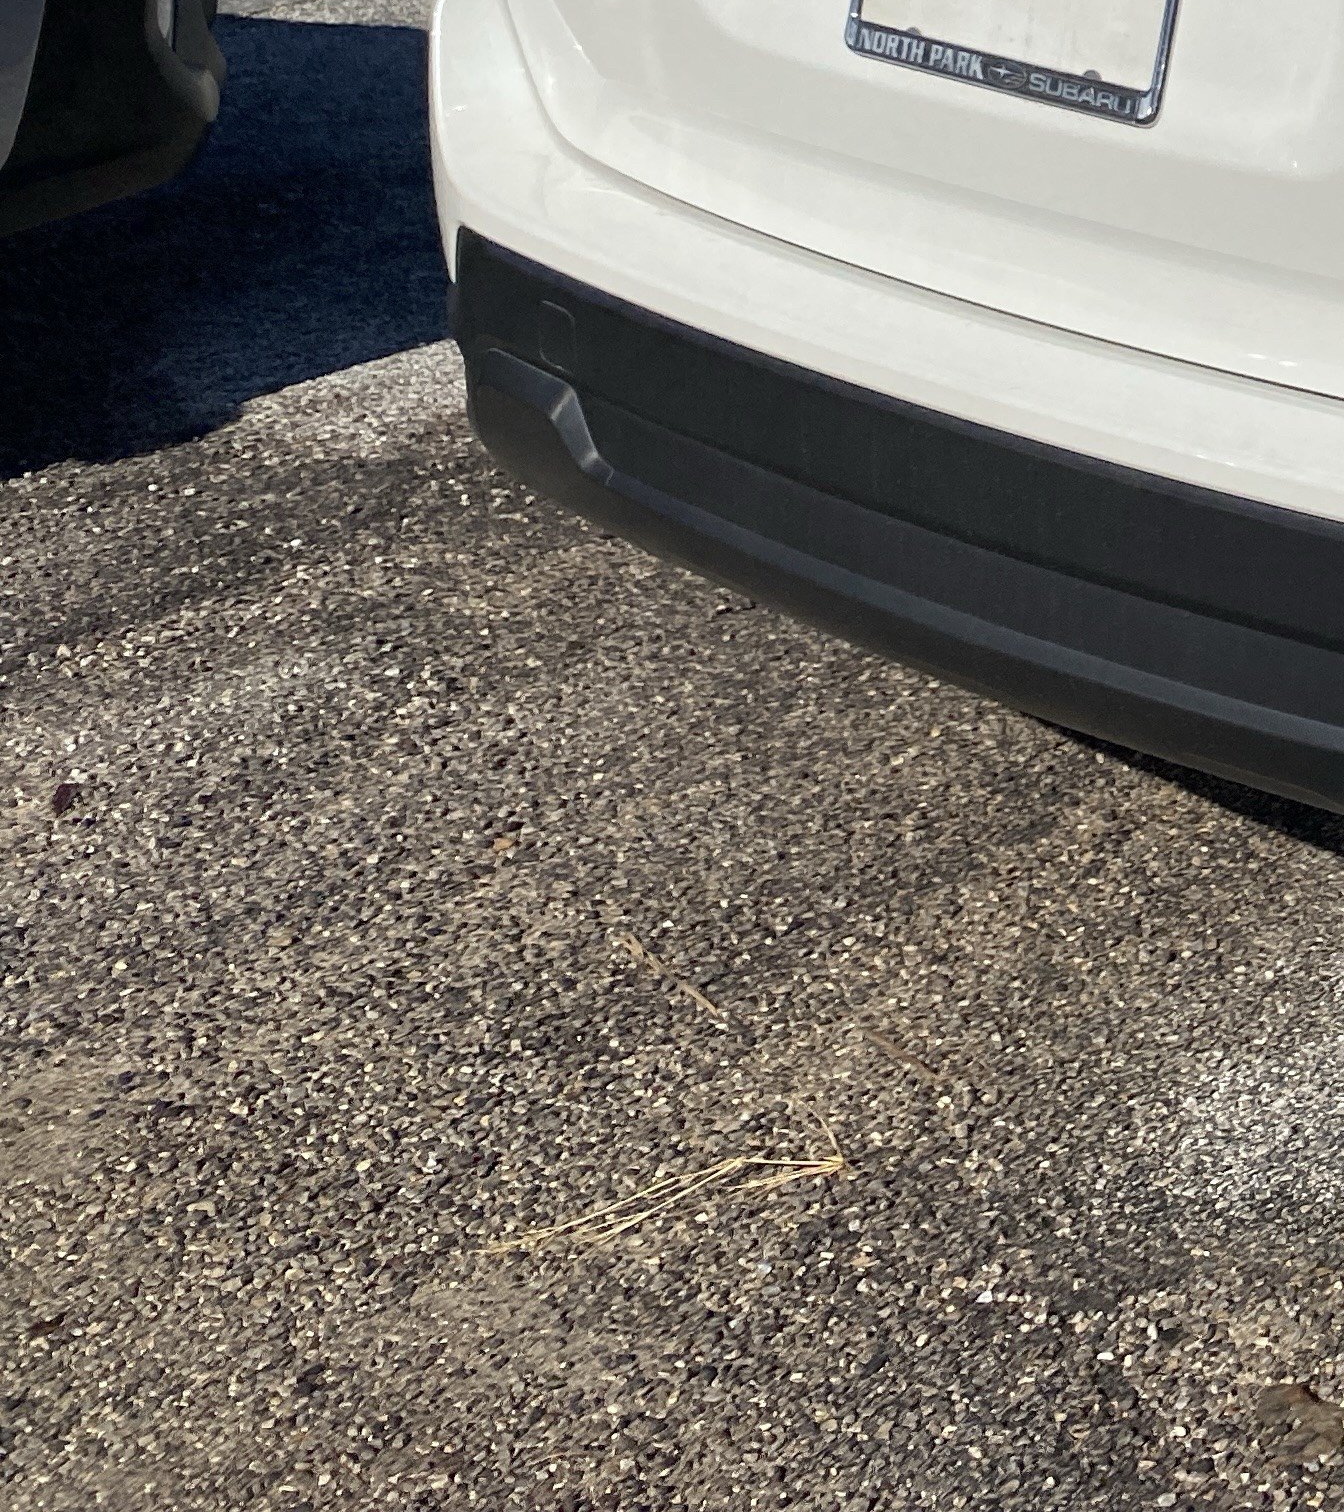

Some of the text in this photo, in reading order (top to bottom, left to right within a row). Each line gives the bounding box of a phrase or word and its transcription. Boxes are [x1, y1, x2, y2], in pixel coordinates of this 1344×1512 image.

[860, 27, 1132, 115] NORTH PARK SUBARU
